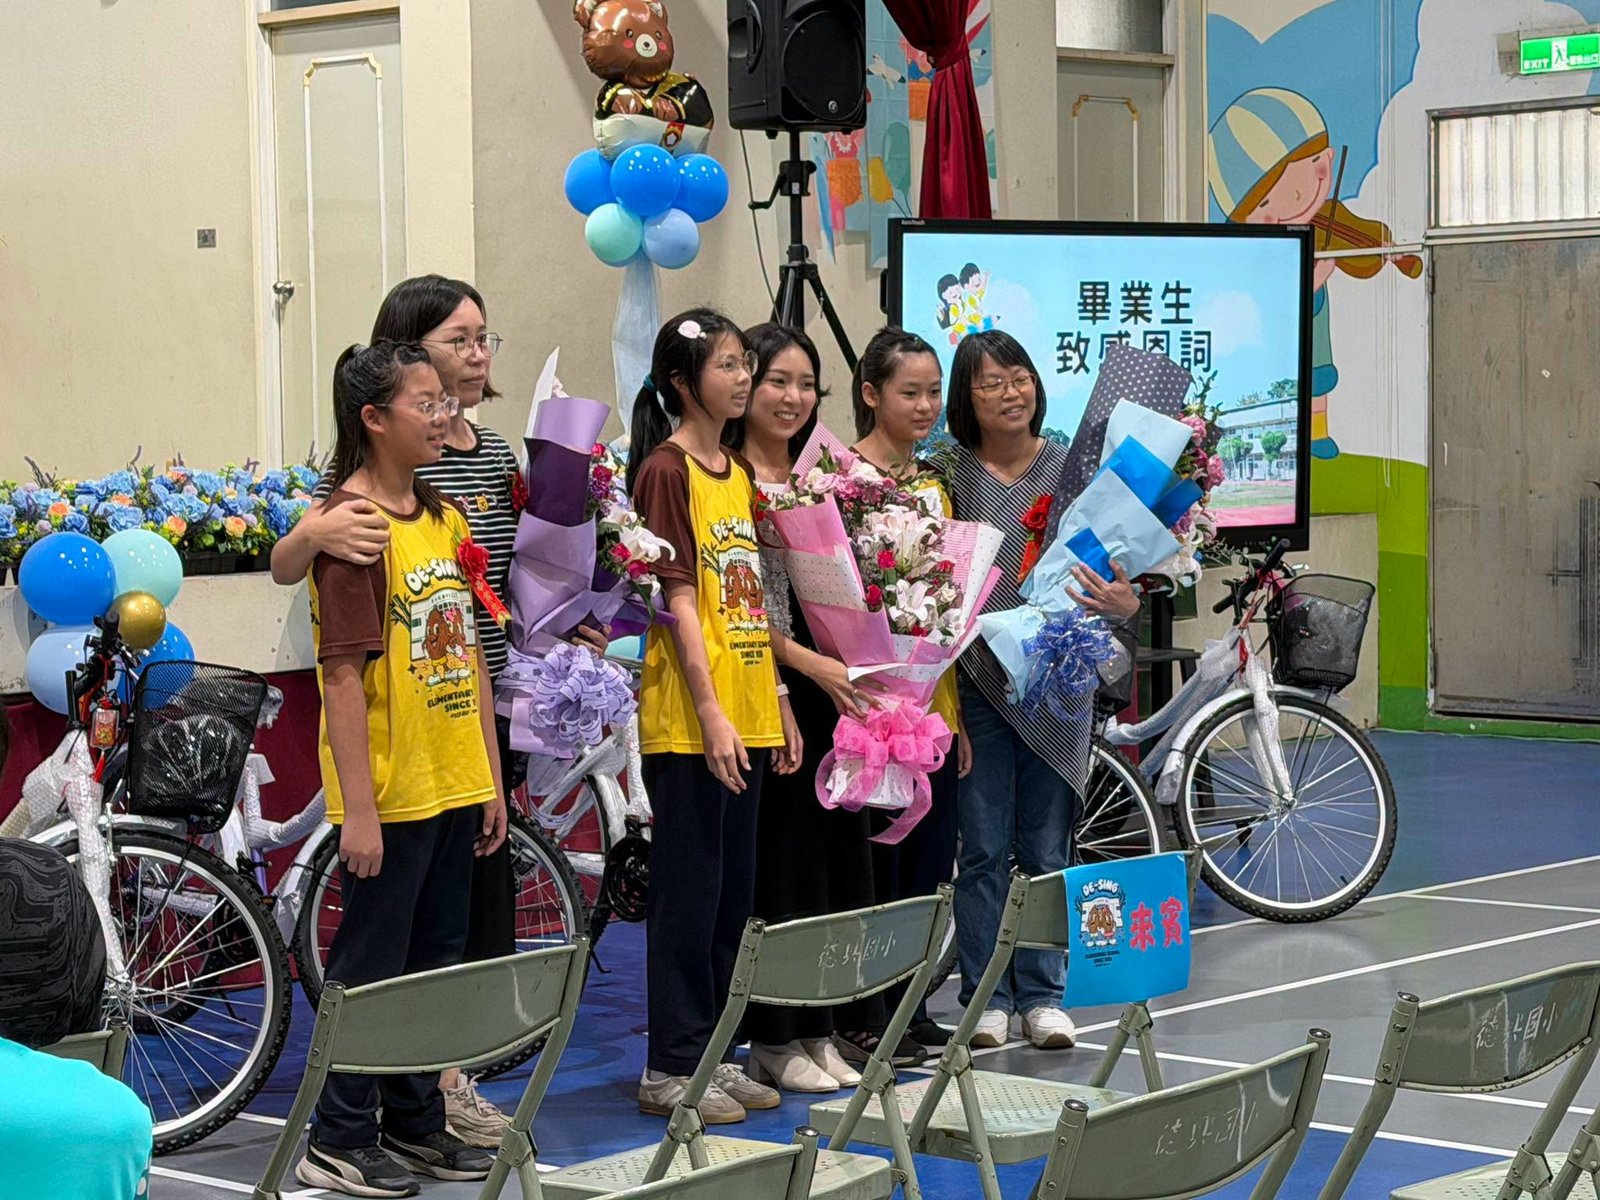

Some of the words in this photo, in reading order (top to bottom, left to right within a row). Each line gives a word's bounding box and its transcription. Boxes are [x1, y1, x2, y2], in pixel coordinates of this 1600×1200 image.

[1523, 58, 1550, 70] EXIT
[1077, 280, 1193, 325] 畢業生
[445, 699, 471, 712] SINCE
[1081, 879, 1120, 897] DE-SING
